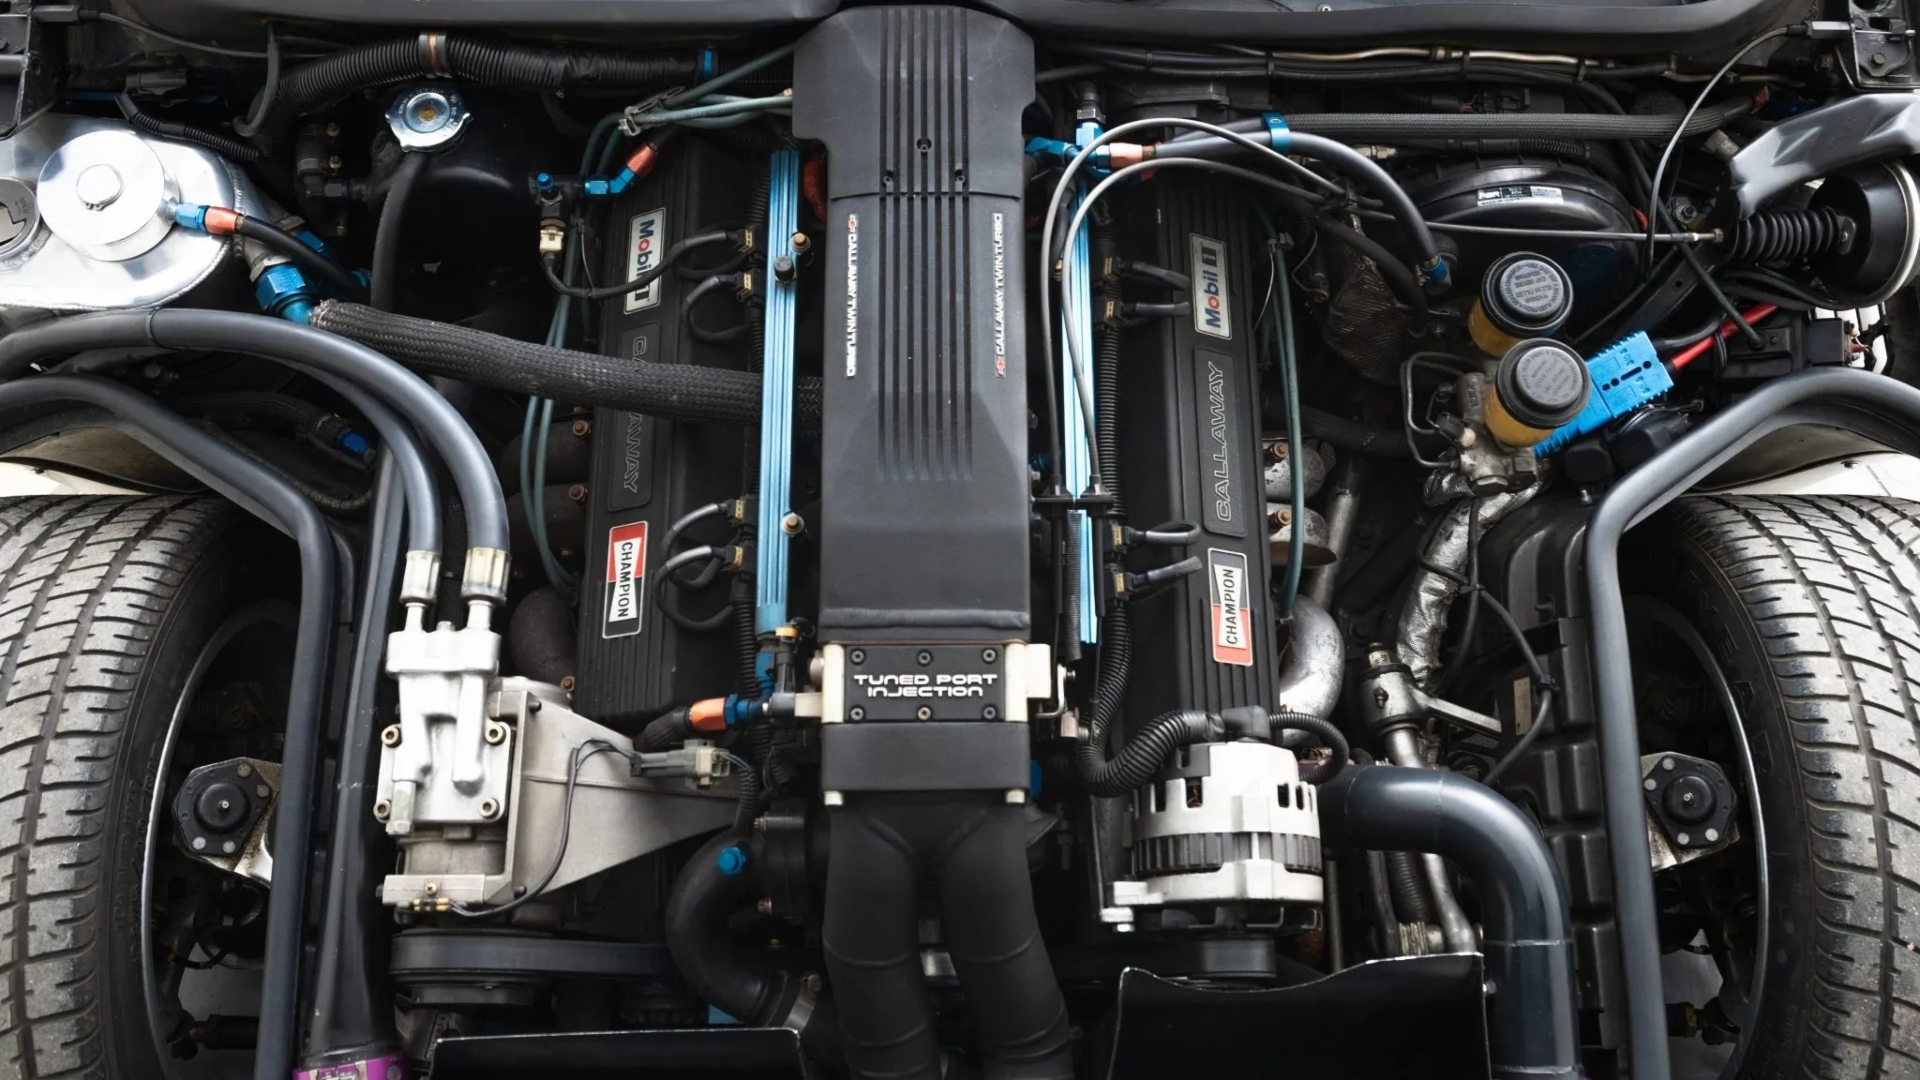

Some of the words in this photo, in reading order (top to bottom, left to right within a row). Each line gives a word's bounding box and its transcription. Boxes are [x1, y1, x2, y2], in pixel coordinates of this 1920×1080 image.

[636, 219, 655, 278] Mobil
[848, 233, 857, 298] CALLAWAY
[996, 289, 1004, 355] CALLAWAY
[1203, 270, 1221, 328] Mobil
[624, 336, 647, 493] CAWAY
[1208, 361, 1232, 522] CALLAWAY
[617, 541, 633, 618] CHAMPION
[1222, 568, 1238, 645] CHAMPION
[854, 674, 929, 685] TUNED
[936, 674, 998, 685] PORT
[868, 686, 983, 697] INJECTION
